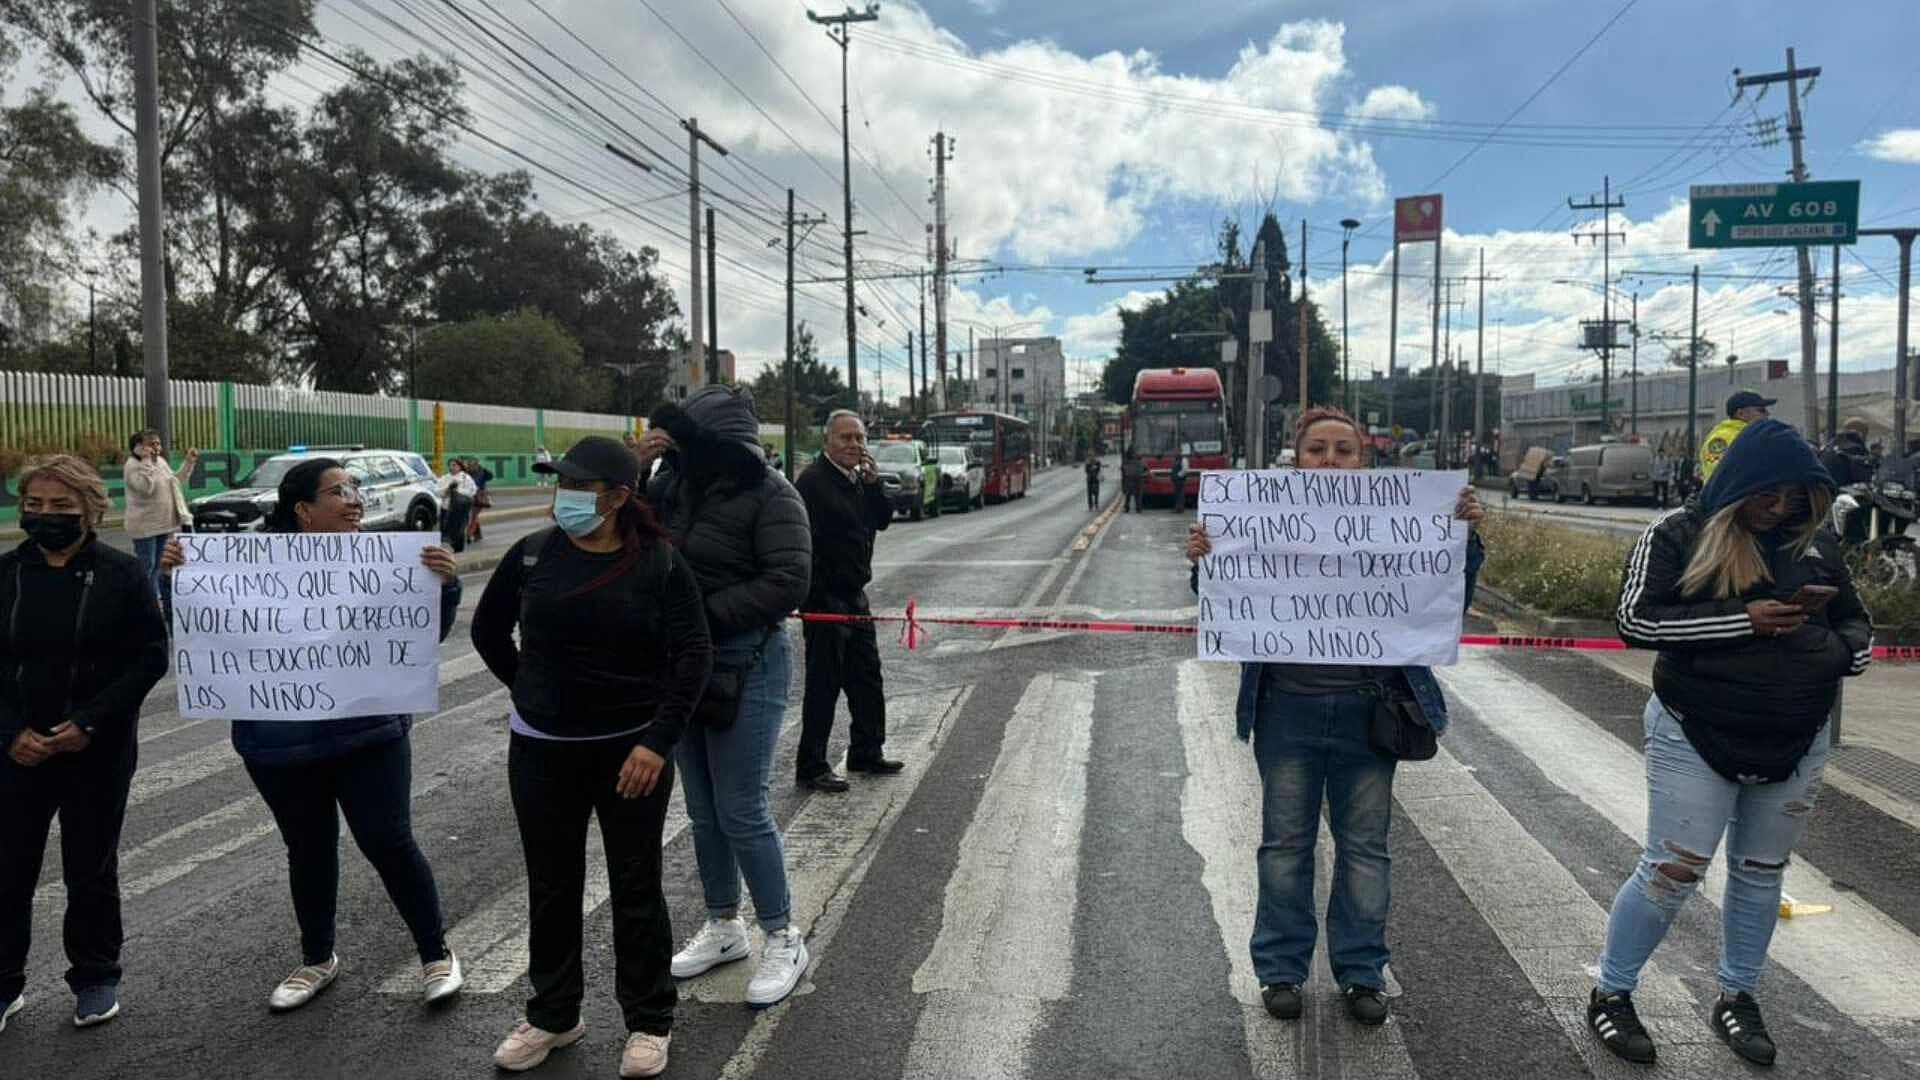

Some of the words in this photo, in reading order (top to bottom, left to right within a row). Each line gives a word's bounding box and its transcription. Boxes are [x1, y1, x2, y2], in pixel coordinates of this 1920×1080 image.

[1744, 203, 1774, 218] AV
[1788, 201, 1838, 217] 608
[1202, 512, 1316, 551] EXIGIMOS
[1334, 513, 1378, 546] QUE
[1391, 515, 1422, 544] NO
[1432, 512, 1459, 542] SE
[223, 535, 273, 564] PRIM
[1201, 553, 1307, 581] VIOLENTE
[1319, 552, 1342, 580] EL
[1352, 548, 1450, 580] DERECHO
[174, 571, 288, 604] EXIGIMOS
[298, 569, 337, 600] QUE
[350, 568, 381, 597] NO
[393, 566, 423, 595] SE
[1201, 596, 1213, 622] A
[1229, 596, 1255, 621] LA
[1271, 581, 1410, 623] EDUCACIÓN
[175, 606, 292, 635] VIOLENTE
[304, 605, 327, 634] EL
[335, 604, 430, 633] DERECHO
[177, 649, 193, 676] A
[211, 649, 241, 676] LA
[248, 640, 371, 674] EDUCACIÓN
[388, 639, 417, 668] DE
[1205, 629, 1229, 657] DE
[1252, 630, 1294, 658] LOS
[1308, 625, 1384, 659] NIÑOS
[184, 683, 226, 710] LOS
[250, 681, 336, 712] NIÑOS
